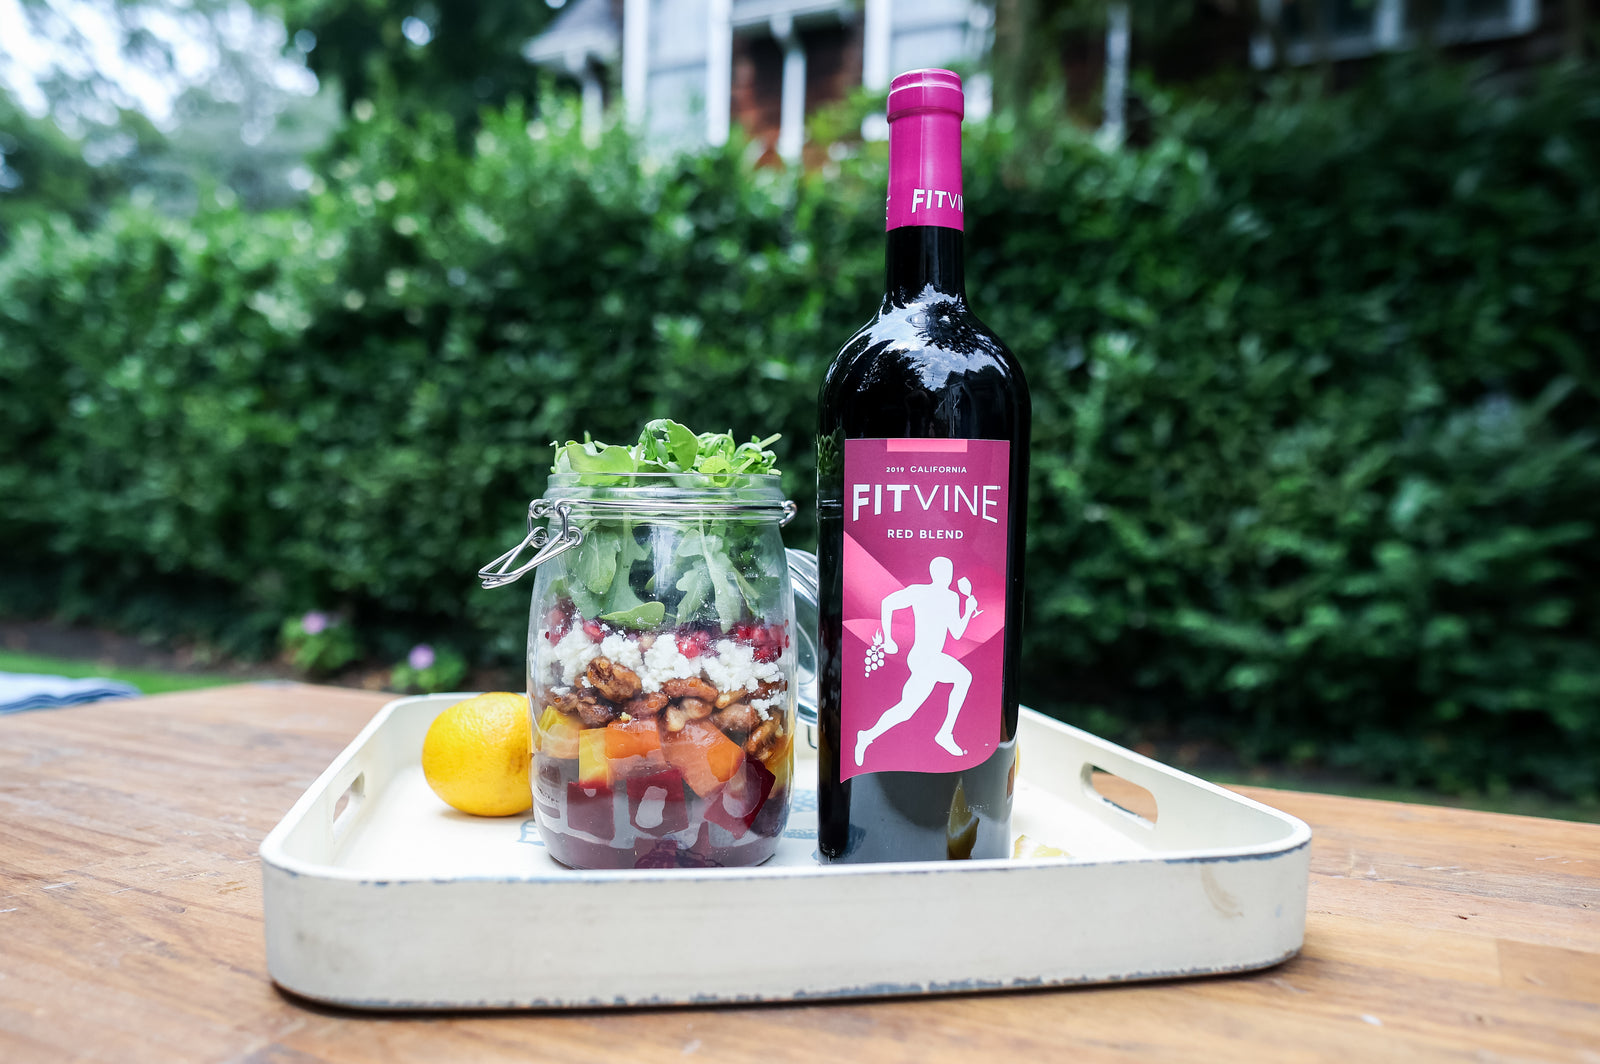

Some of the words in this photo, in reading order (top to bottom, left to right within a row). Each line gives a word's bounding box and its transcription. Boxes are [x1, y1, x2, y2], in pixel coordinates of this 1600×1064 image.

[910, 465, 967, 474] CALIFORNIA
[852, 484, 1001, 524] FITVINE
[887, 529, 914, 539] RED
[919, 530, 964, 540] BLEND
